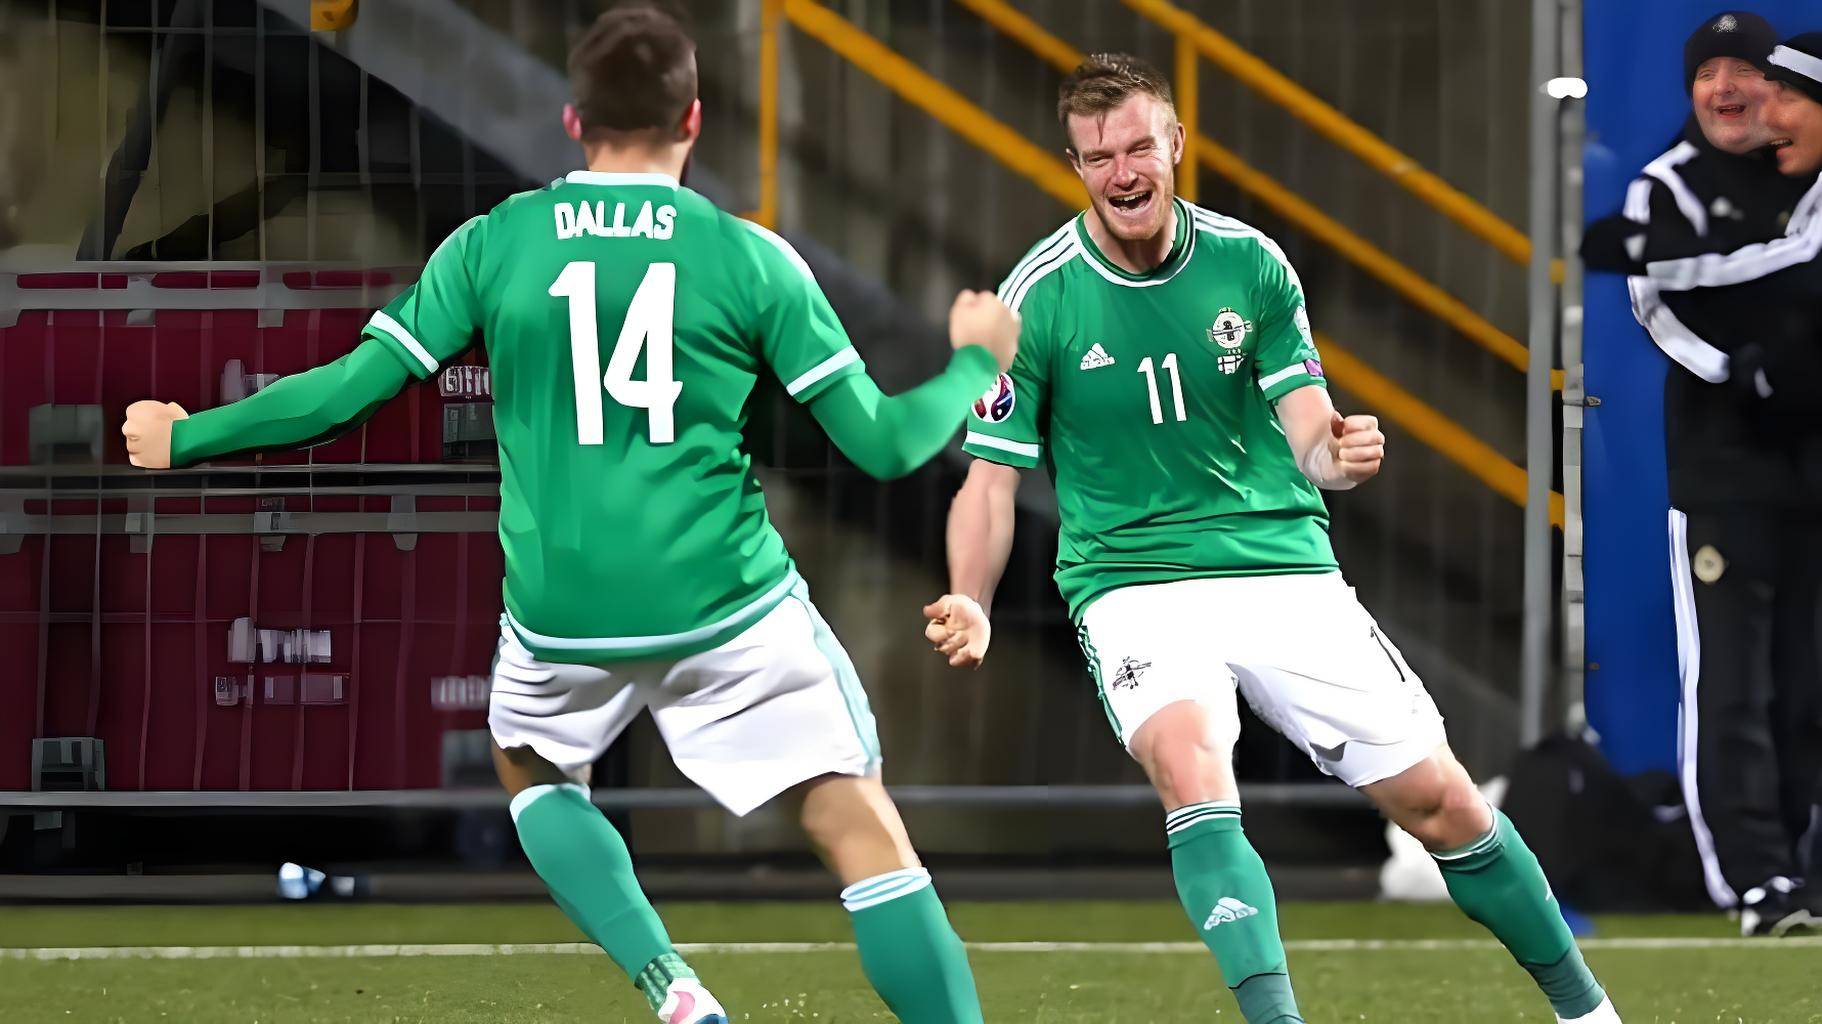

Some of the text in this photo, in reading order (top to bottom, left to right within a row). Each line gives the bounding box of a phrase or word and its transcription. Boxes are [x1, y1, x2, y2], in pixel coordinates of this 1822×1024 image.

[554, 200, 677, 240] DALLAS
[548, 261, 683, 445] 14
[1137, 352, 1187, 425] 11
